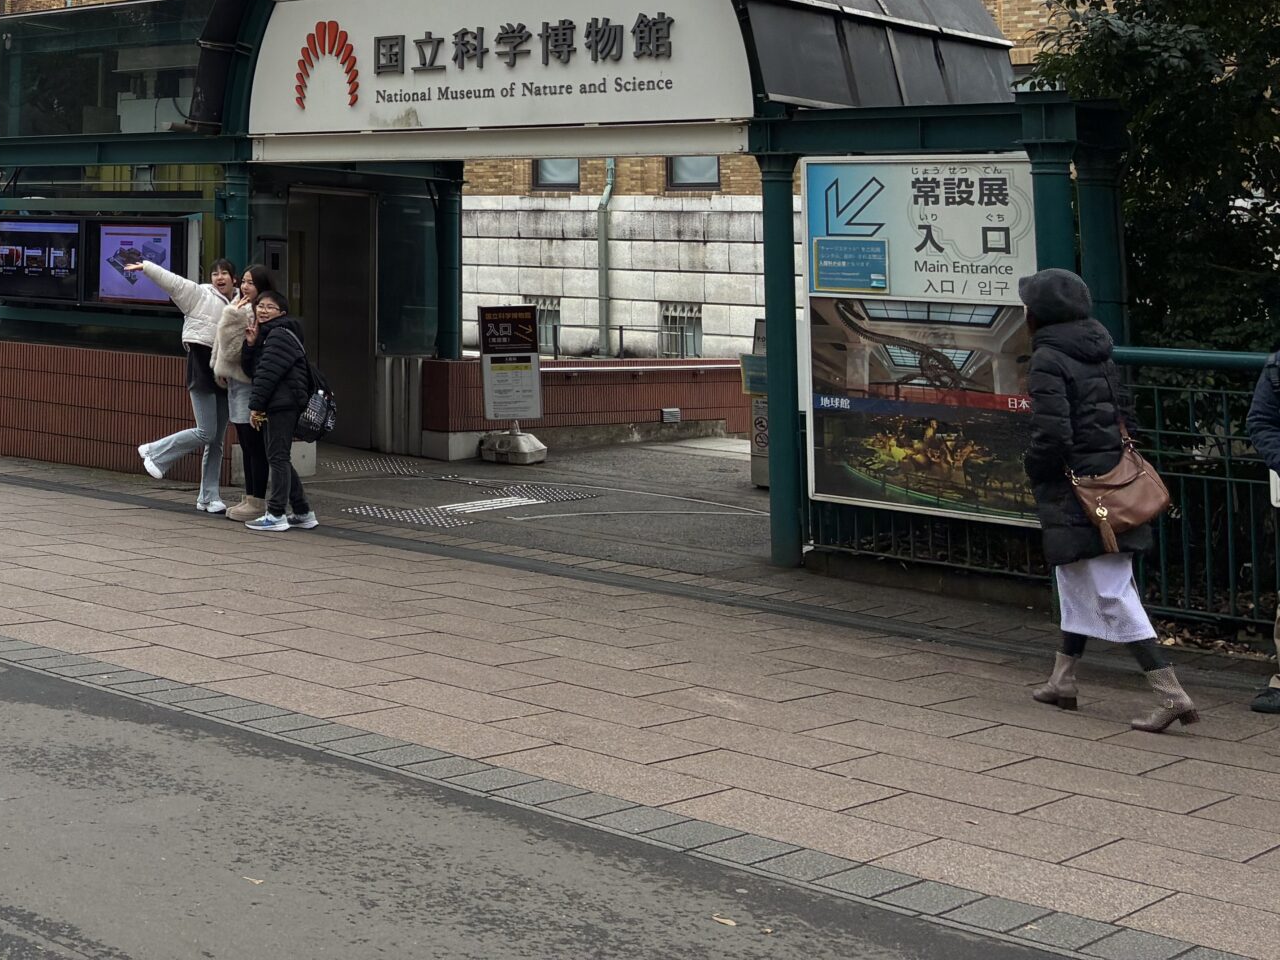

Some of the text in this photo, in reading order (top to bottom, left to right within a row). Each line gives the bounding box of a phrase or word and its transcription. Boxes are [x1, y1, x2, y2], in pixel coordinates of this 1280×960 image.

[373, 12, 675, 75] 国立科学博物館
[375, 77, 673, 104] National Museum of Nature and Science
[911, 176, 1009, 206] 常設展
[919, 213, 1005, 222] いり ぐち
[914, 224, 1012, 254] 入口
[914, 260, 1013, 275] Main Entrance
[924, 279, 955, 294] 入口
[977, 280, 1010, 296] 입구
[486, 323, 512, 336] 入口
[820, 396, 850, 409] 地球館
